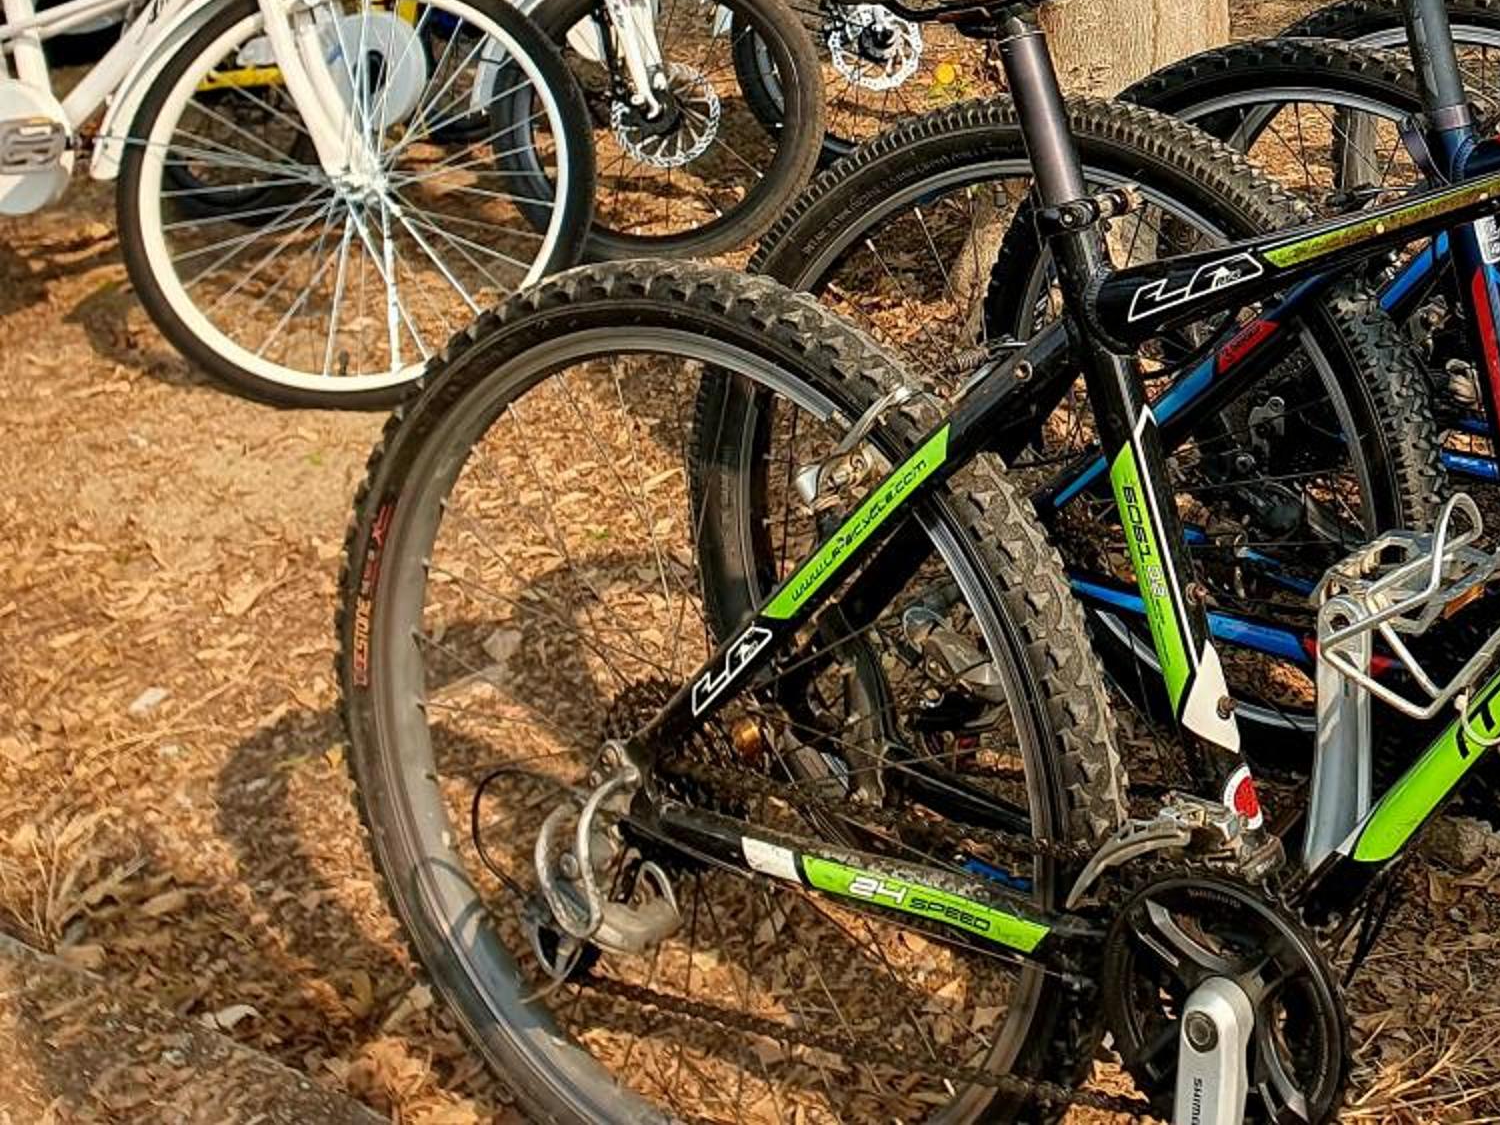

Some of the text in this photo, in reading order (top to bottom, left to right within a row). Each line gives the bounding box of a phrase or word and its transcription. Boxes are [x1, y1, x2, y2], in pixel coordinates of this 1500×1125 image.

[1123, 485, 1152, 562] 6061
[850, 876, 991, 933] 24 SPEED
